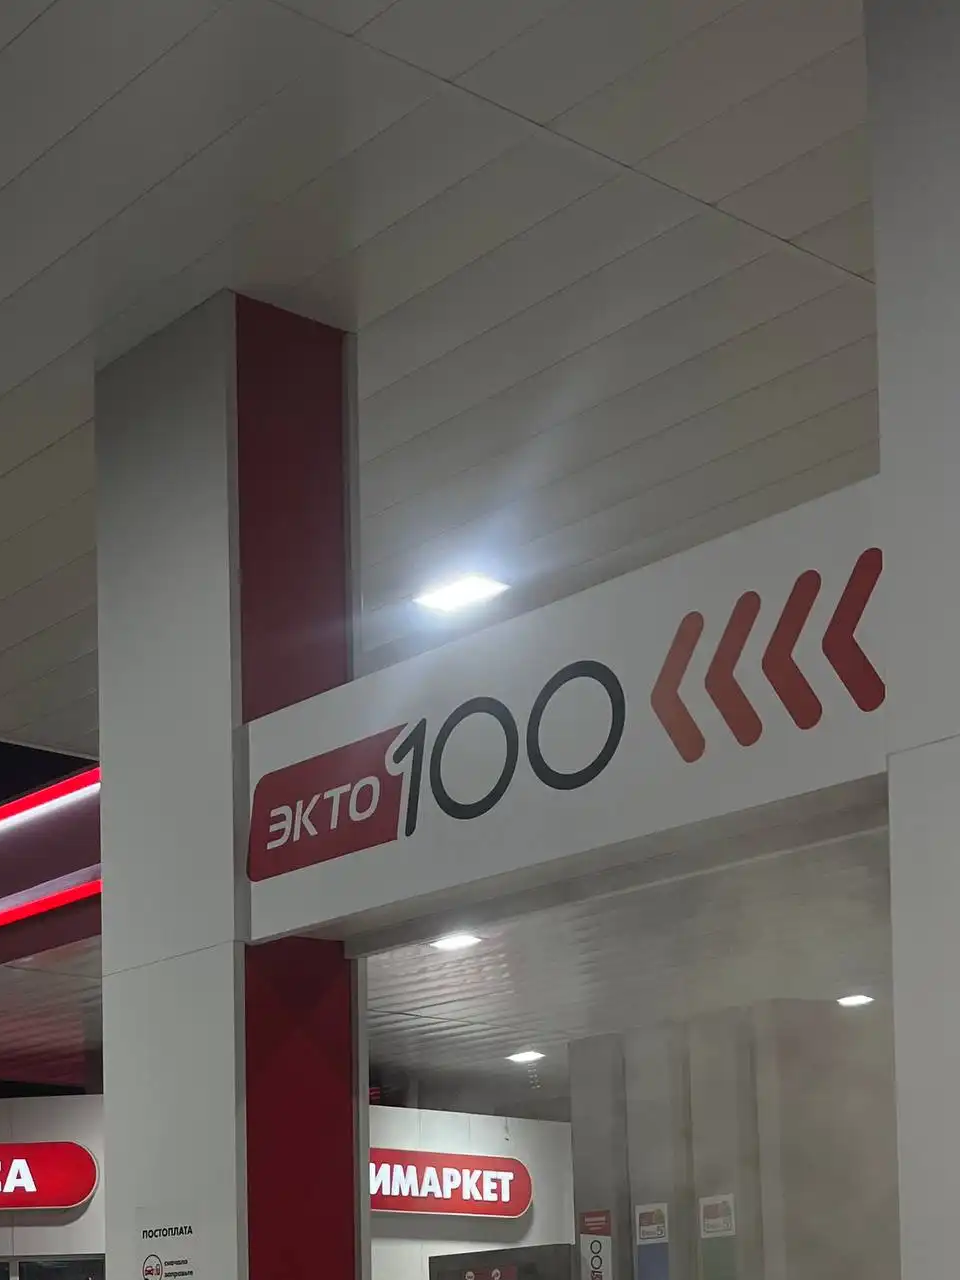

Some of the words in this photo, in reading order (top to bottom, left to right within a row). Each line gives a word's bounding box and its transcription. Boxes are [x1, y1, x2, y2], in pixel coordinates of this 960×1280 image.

[266, 774, 381, 851] ЭКТО
[392, 659, 626, 837] 100
[142, 1225, 193, 1239] ПОСТОПЛАТА
